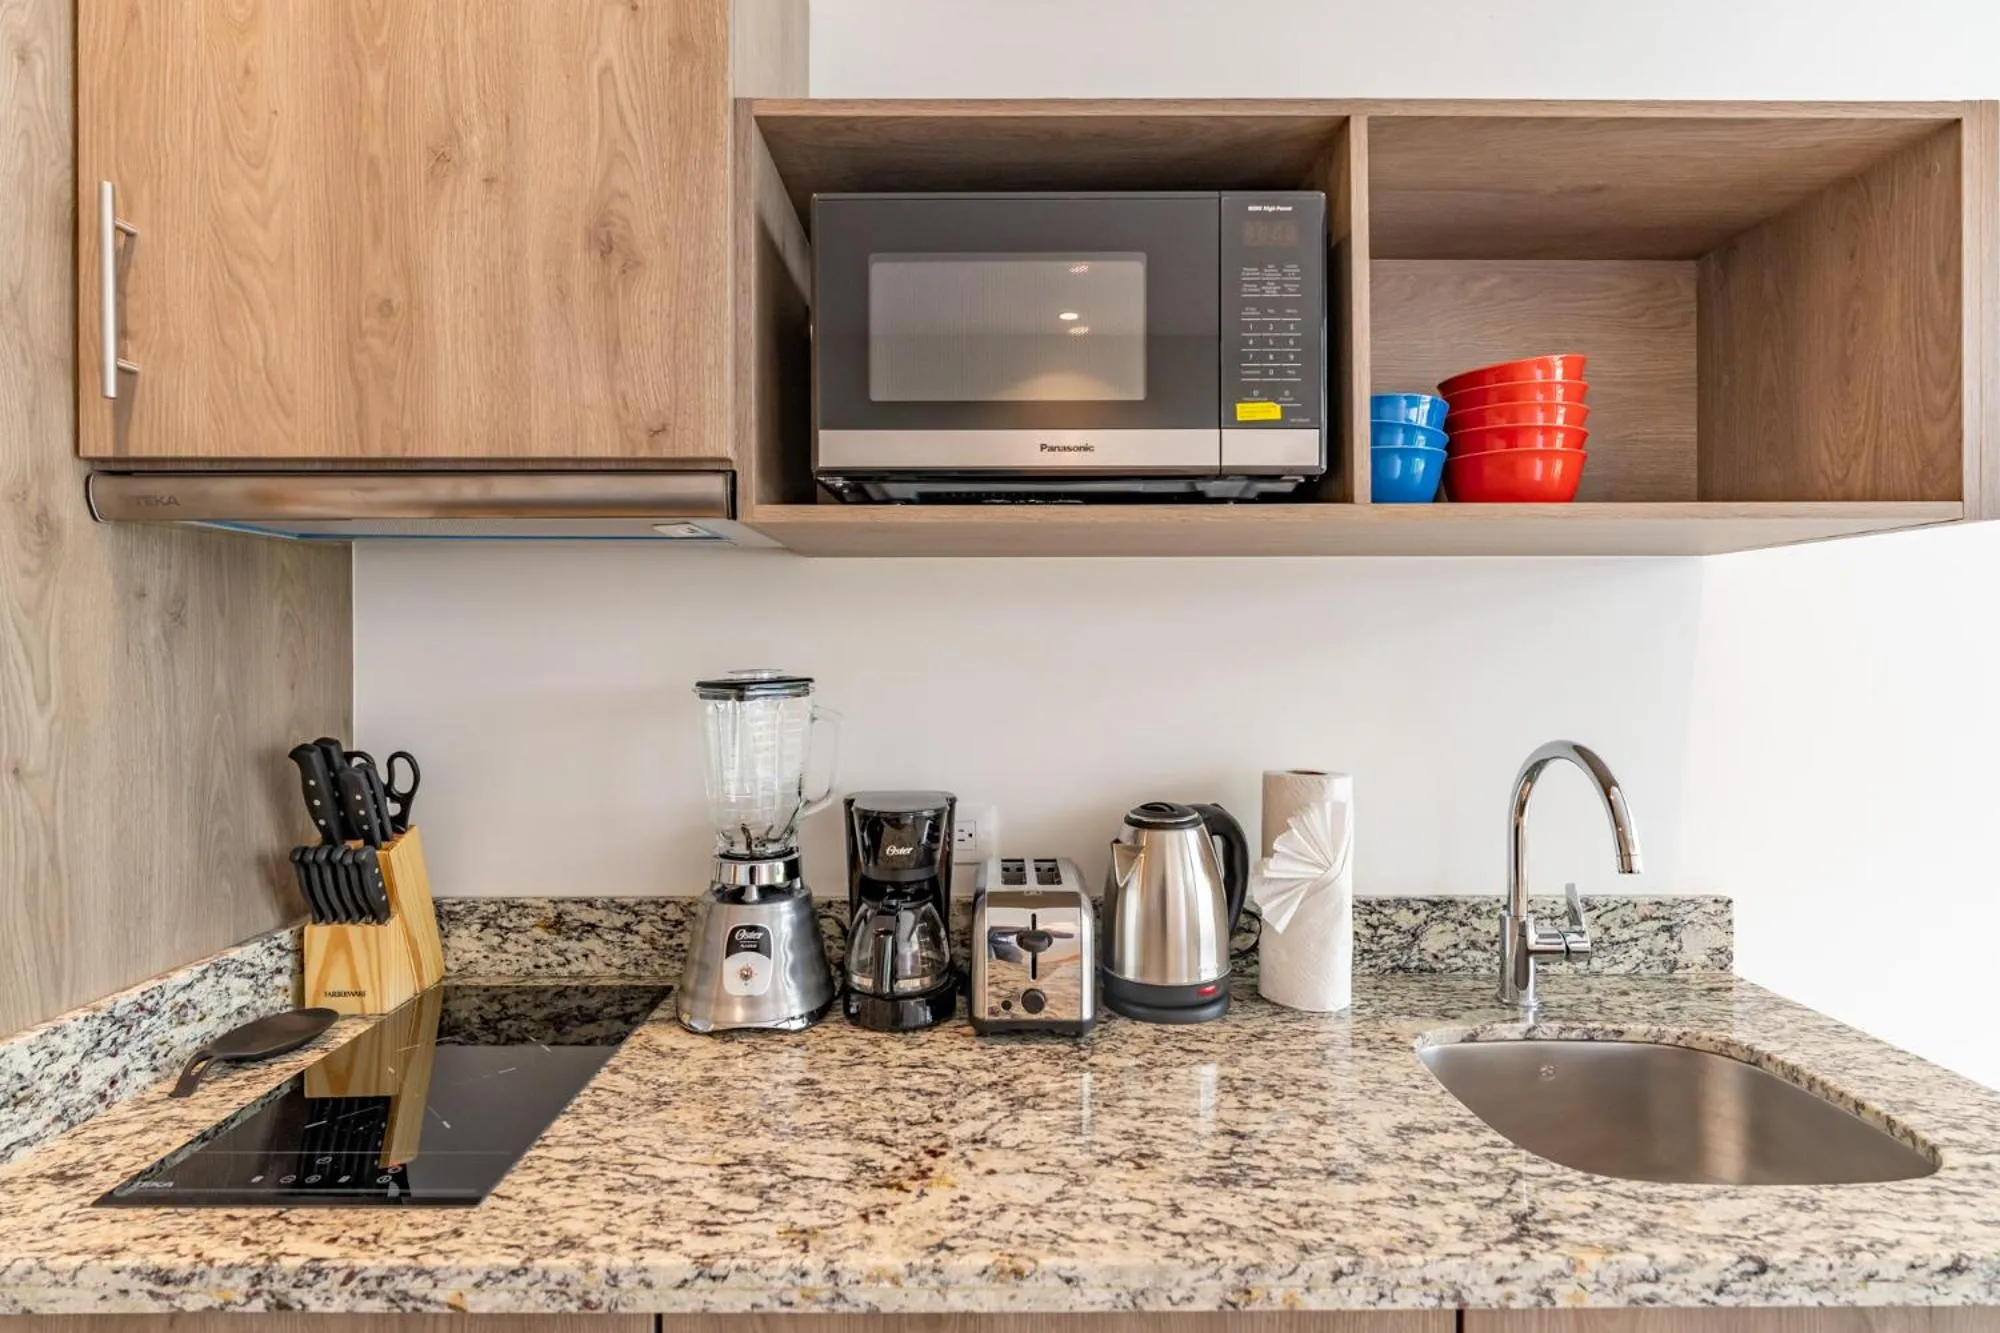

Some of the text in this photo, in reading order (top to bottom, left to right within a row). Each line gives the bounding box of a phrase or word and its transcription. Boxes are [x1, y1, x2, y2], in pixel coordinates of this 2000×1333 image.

[1040, 443, 1095, 452] Panasonic
[135, 495, 180, 506] TEKA
[886, 845, 914, 856] Oster
[735, 929, 764, 940] Oster
